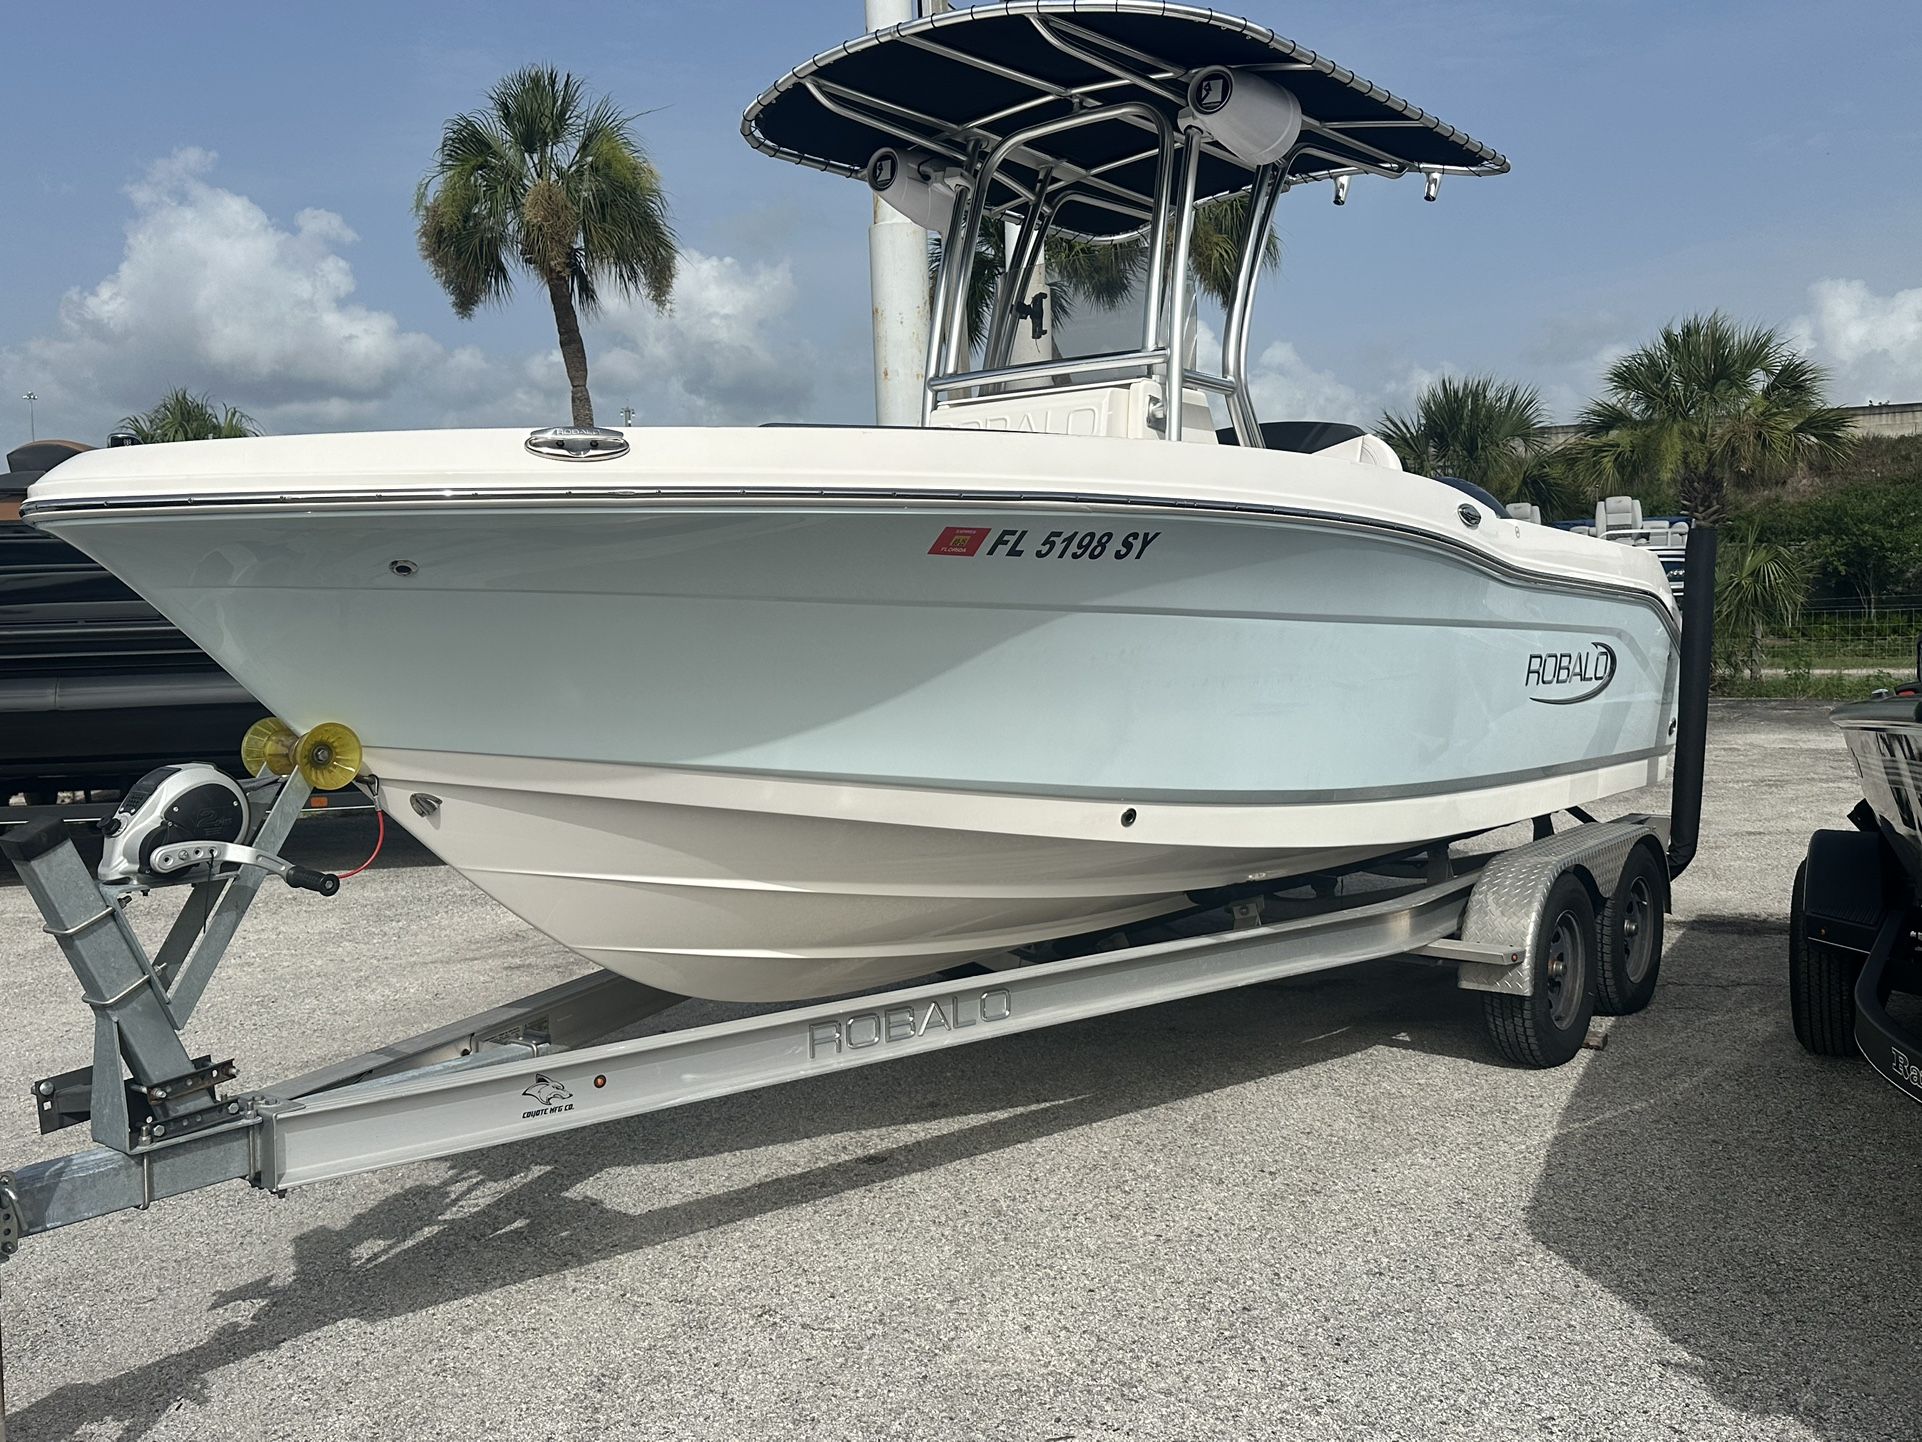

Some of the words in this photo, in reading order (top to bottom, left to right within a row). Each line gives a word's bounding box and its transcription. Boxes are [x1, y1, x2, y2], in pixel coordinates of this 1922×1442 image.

[986, 529, 1029, 557] FL
[1035, 531, 1114, 560] 5198
[1114, 531, 1162, 560] SY
[1525, 651, 1609, 687] ROBALO
[808, 987, 1012, 1060] ROBALO
[522, 1107, 549, 1119] COYOTE
[549, 1104, 563, 1115] MFG
[564, 1103, 575, 1112] CO.
